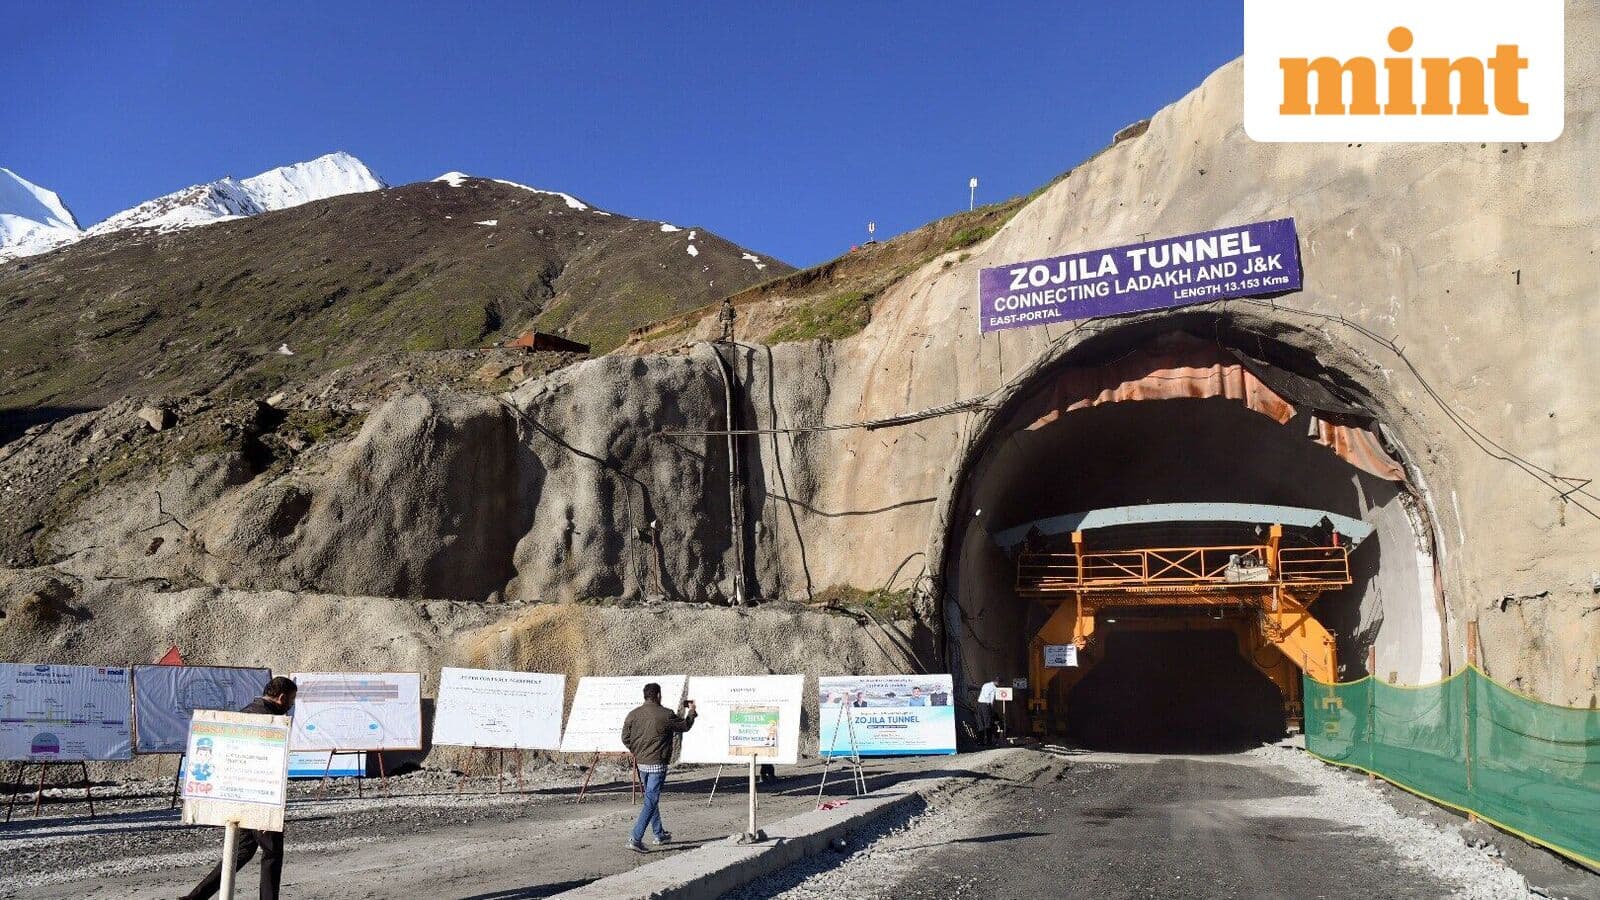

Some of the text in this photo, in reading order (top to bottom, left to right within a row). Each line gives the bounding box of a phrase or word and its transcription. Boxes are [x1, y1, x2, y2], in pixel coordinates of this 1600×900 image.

[1009, 230, 1261, 291] ZOJILA TUNNEL
[994, 253, 1283, 312] CONNECTING LADAKH AND J&K
[1173, 275, 1290, 300] LENGTH 13.153 Kms
[989, 308, 1062, 326] EAST-PORTAL
[855, 715, 920, 725] ZOJILA TUNNEL
[187, 780, 213, 795] STOP
